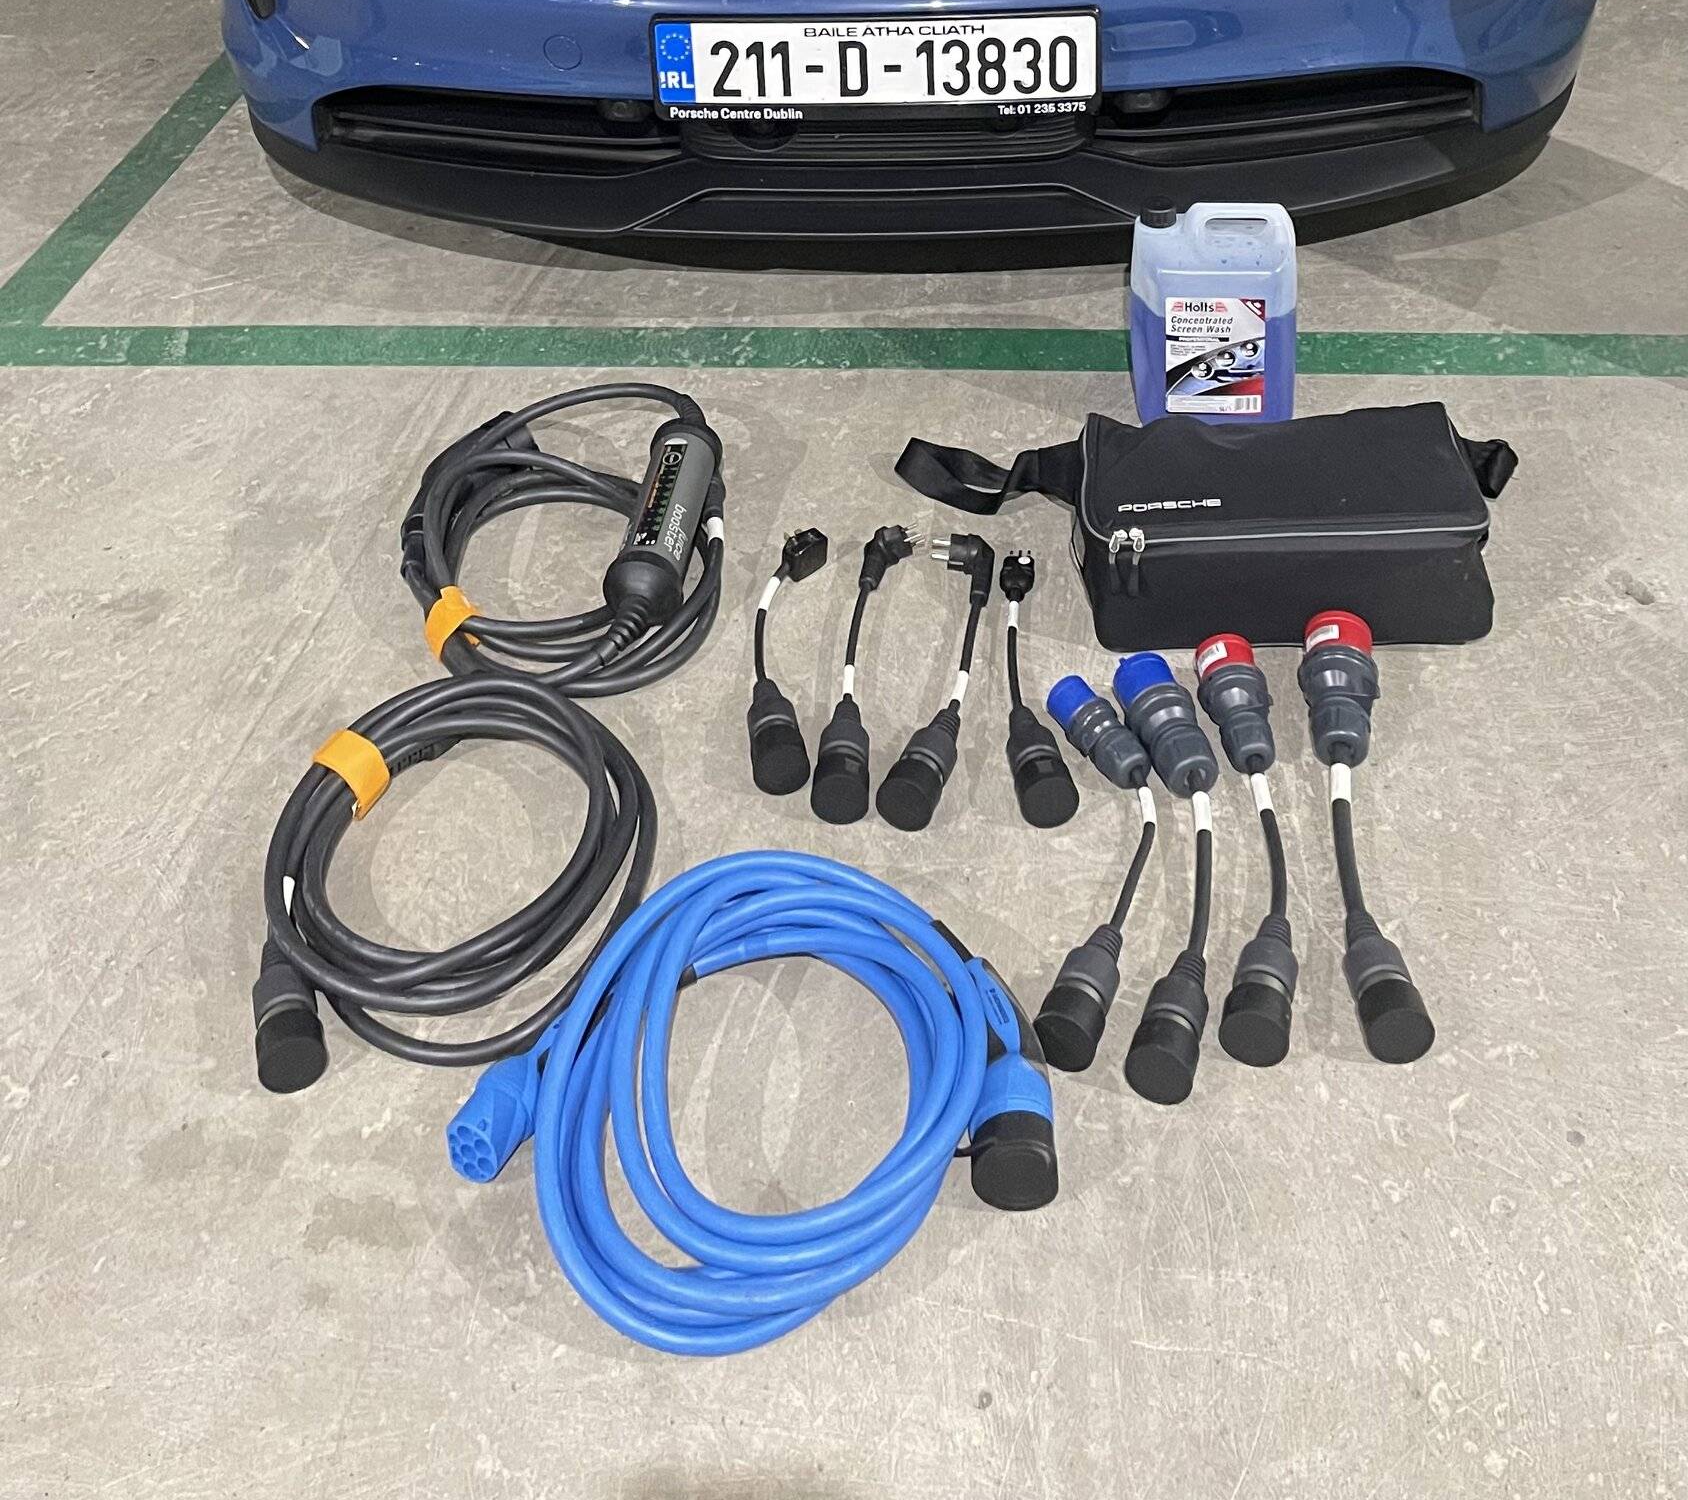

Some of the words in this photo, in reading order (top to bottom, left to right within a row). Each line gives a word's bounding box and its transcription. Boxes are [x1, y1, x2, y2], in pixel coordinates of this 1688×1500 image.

[804, 27, 858, 37] BAILE
[918, 24, 985, 36] CLIATH
[710, 37, 1078, 97] 211-D-13830
[669, 106, 719, 120] Porsche
[720, 107, 762, 120] Centre
[763, 107, 803, 120] Dublin
[1017, 104, 1031, 114] 01
[1057, 102, 1087, 113] 3375
[1184, 302, 1215, 312] Holts
[1171, 316, 1233, 325] Concentrated
[1171, 325, 1203, 333] Screen
[1206, 325, 1231, 333] Wash
[1117, 498, 1222, 512] PORSCHE
[664, 503, 687, 552] booster
